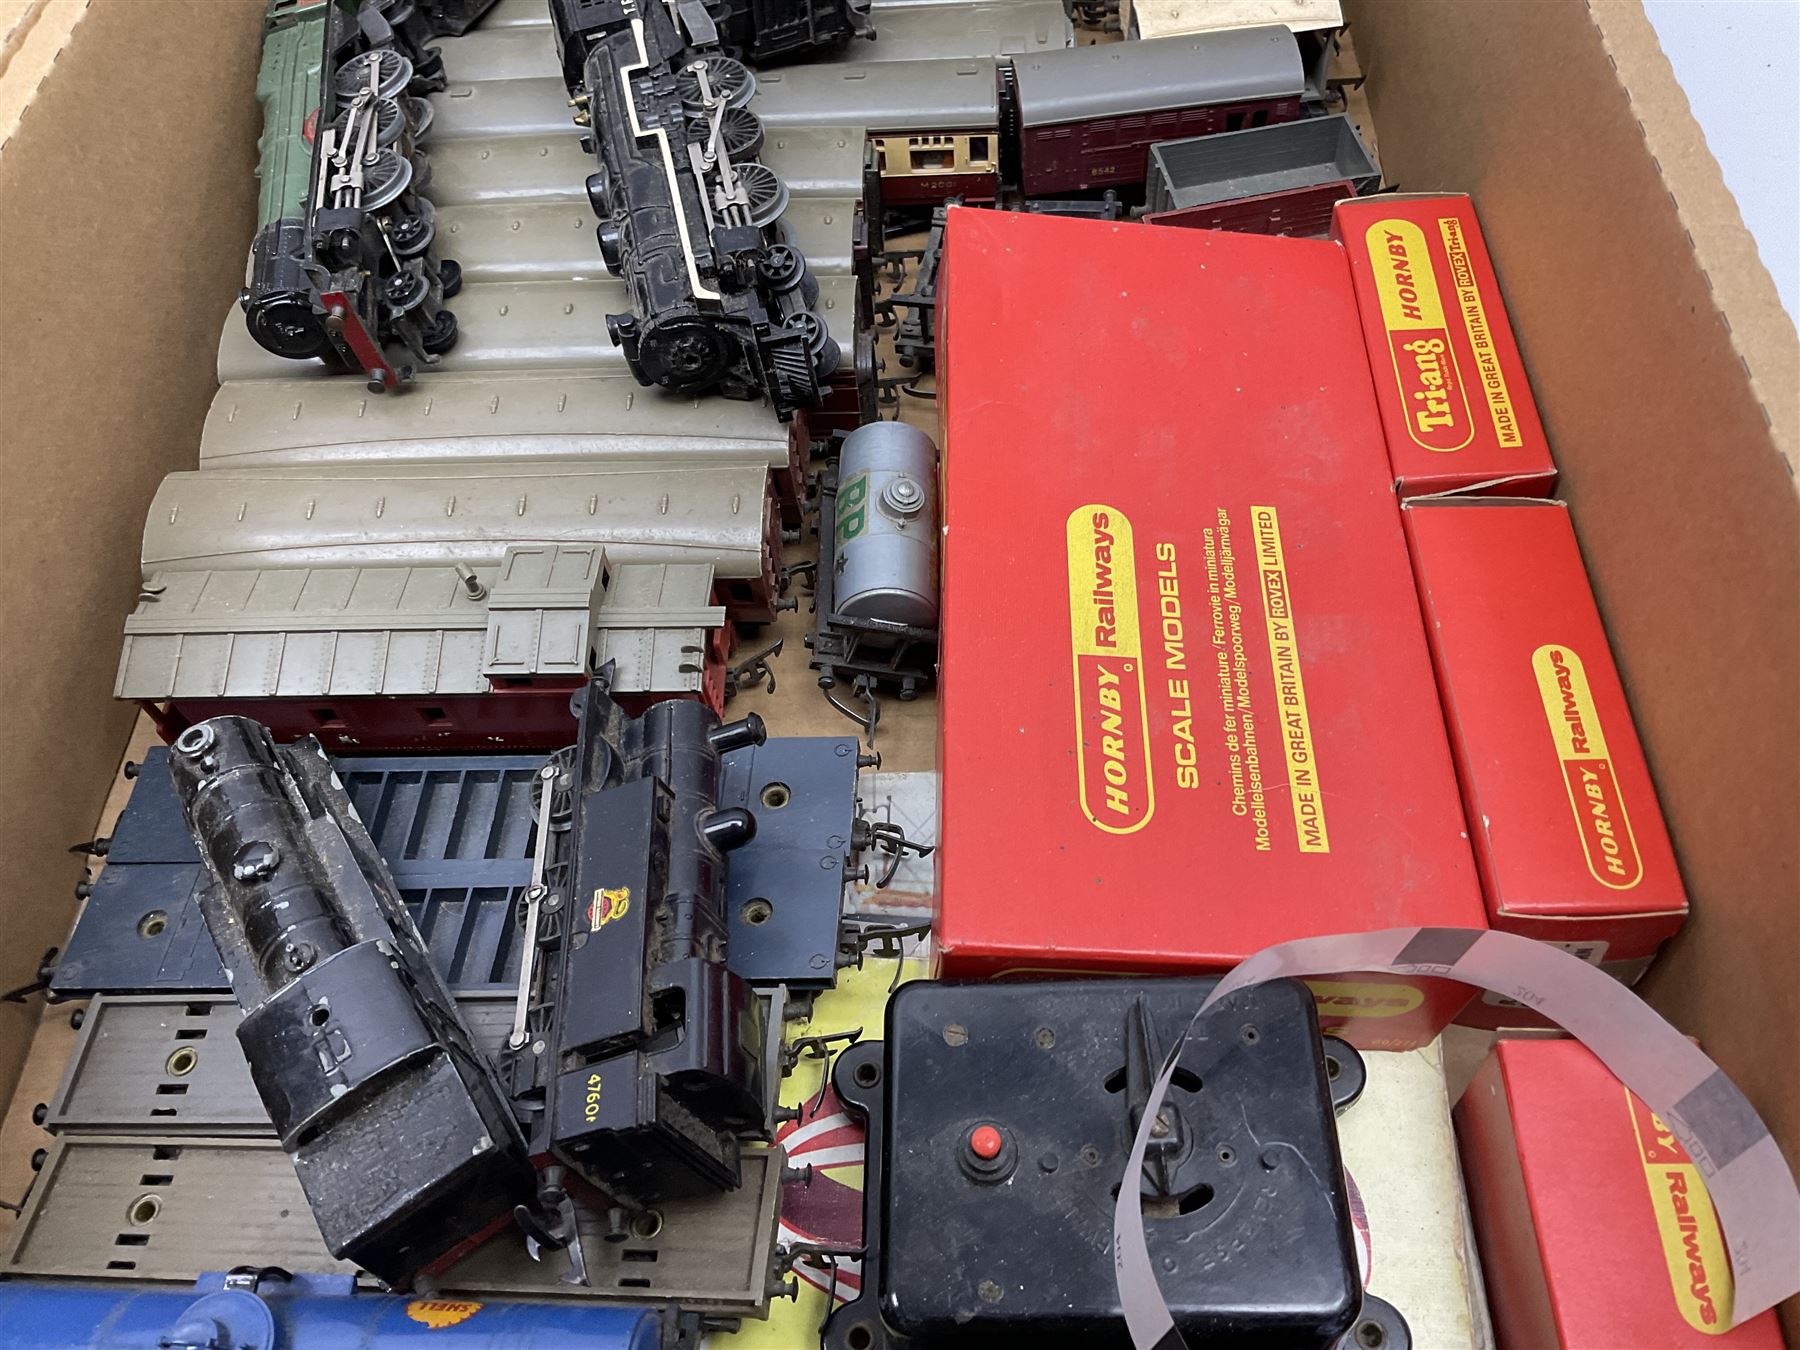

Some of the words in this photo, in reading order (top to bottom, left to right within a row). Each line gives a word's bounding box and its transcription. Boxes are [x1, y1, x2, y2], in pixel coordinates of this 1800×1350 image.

[1384, 230, 1422, 320] HORNBY
[1453, 252, 1471, 286] ROVEX
[1462, 290, 1476, 302] BY
[1467, 306, 1488, 348] BRITAIN
[1403, 339, 1454, 432] Tri-ang
[1478, 352, 1500, 388] GREAT
[1490, 392, 1505, 404] IN
[1495, 407, 1516, 442] MADE
[1202, 528, 1218, 581] miniatura
[1257, 511, 1279, 566] LIMITED
[1092, 512, 1117, 648] Railways
[1156, 543, 1186, 670] MODELS
[1207, 583, 1219, 594] in
[1265, 571, 1285, 617] ROVEX
[1274, 622, 1290, 641] BY
[1277, 646, 1299, 705] BRITAIN
[1550, 649, 1590, 754] Railways
[1097, 664, 1129, 815] HORNBY
[1168, 679, 1199, 789] SCALE
[1224, 714, 1237, 732] fer
[1225, 734, 1239, 752] de
[1286, 710, 1308, 763] GREAT
[1228, 754, 1247, 816] Chemins
[1294, 769, 1312, 786] IN
[1299, 793, 1321, 847] MADE
[1579, 767, 1626, 876] HORNBY
[1666, 1171, 1717, 1325] Railways
